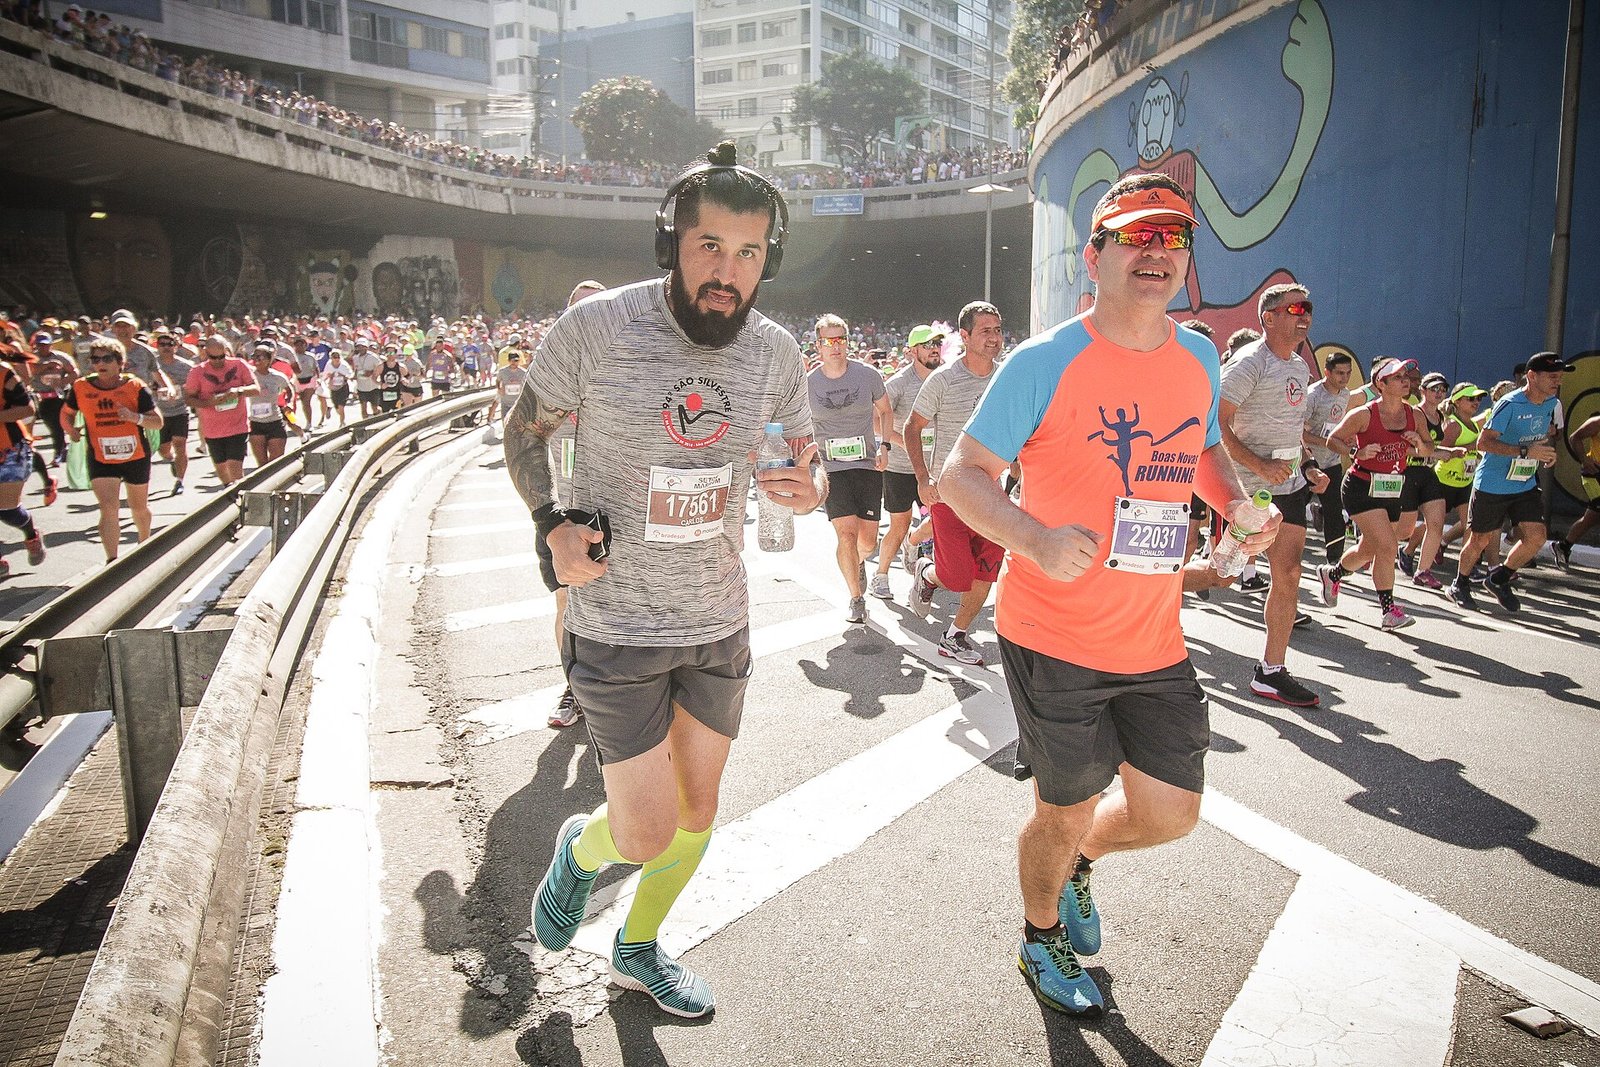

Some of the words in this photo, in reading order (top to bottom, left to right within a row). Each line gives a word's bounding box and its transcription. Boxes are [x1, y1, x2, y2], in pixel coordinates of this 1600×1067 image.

[673, 376, 694, 392] SÃO
[697, 376, 733, 413] SILVESTRE
[838, 446, 856, 455] 4314
[1151, 450, 1176, 463] Boas
[1177, 452, 1198, 464] Novas
[1135, 465, 1195, 483] RUNNING
[667, 490, 717, 517] 17561
[681, 517, 703, 526] CARLOS
[1128, 524, 1177, 549] 22031
